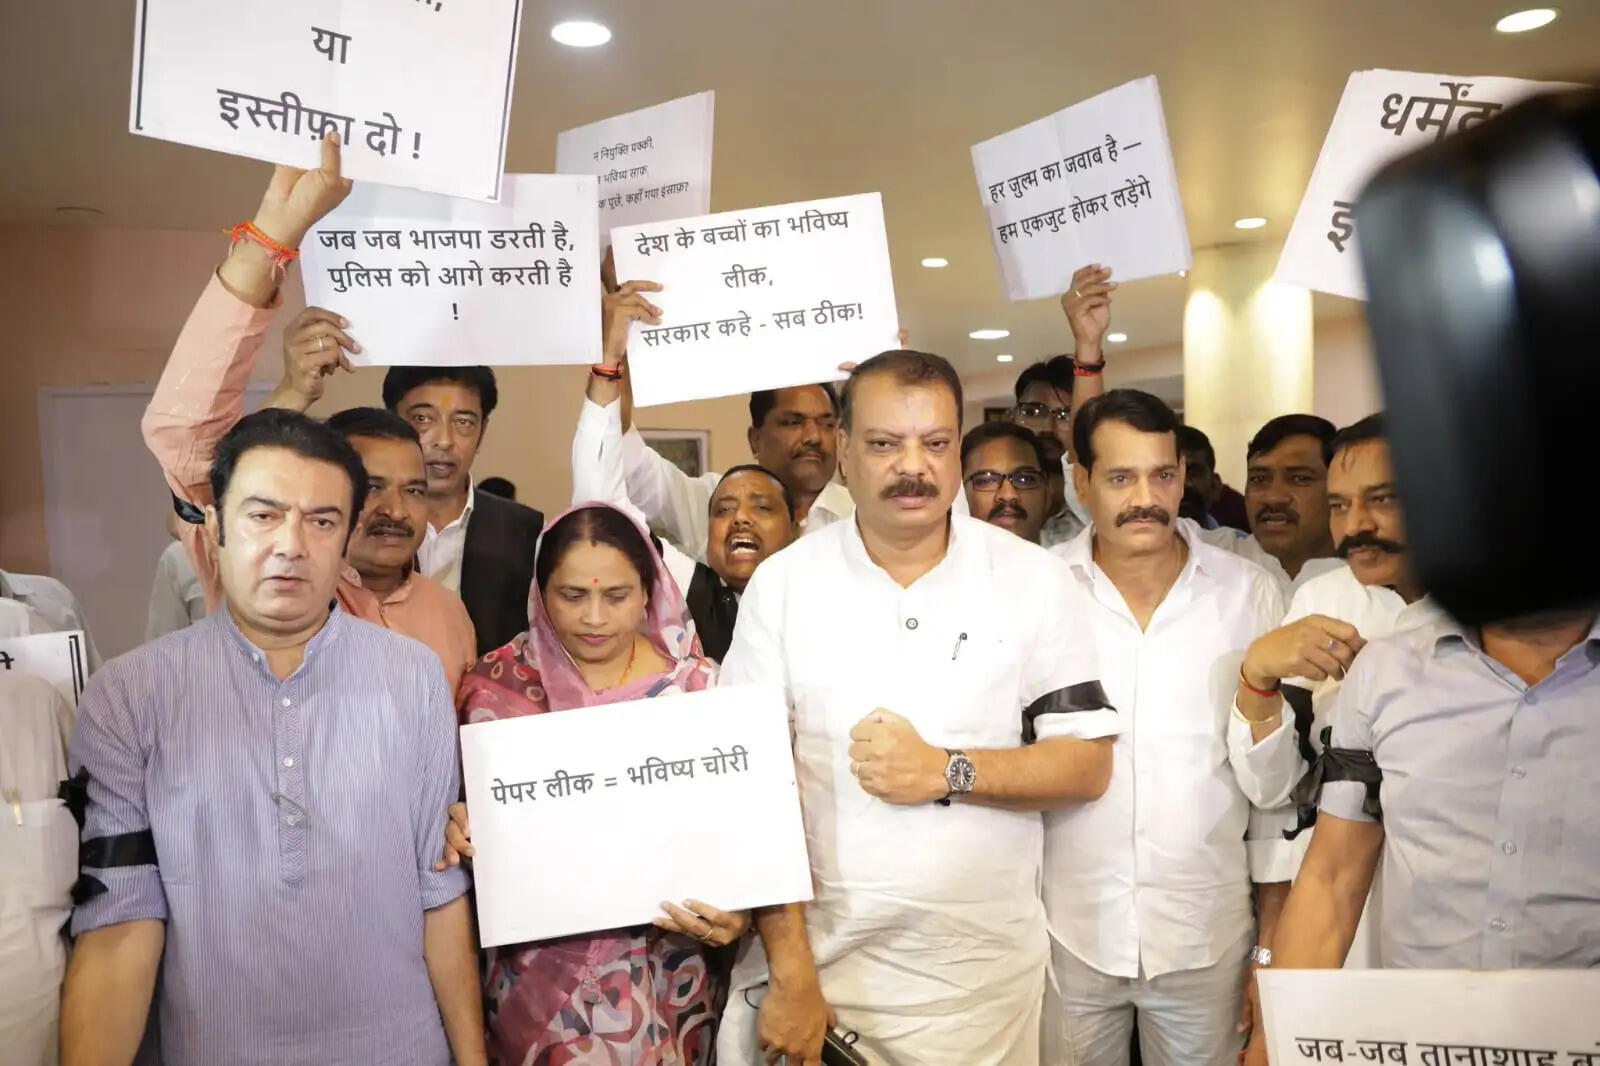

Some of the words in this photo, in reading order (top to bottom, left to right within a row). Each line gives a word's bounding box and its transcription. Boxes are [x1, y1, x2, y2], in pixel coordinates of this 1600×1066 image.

[310, 26, 353, 65] या
[364, 111, 403, 157] दो
[600, 143, 629, 161] नियुक्ति
[604, 169, 628, 183] भविष्य
[988, 181, 1006, 204] हर
[1007, 169, 1039, 199] जुल्म
[1039, 161, 1062, 182] का
[1063, 145, 1103, 173] जवाब
[1105, 133, 1118, 163] है
[625, 188, 643, 205] कहाँ
[645, 188, 660, 199] गया
[996, 222, 1019, 245] हम
[1019, 207, 1067, 238] एकजुट
[1068, 193, 1109, 224] होकर
[1110, 174, 1152, 208] लड़ेंगे
[316, 230, 357, 250] जब
[361, 230, 402, 250] जब
[409, 229, 482, 250] भाजपा
[487, 222, 546, 250] डरती
[551, 220, 574, 252] है,
[634, 232, 670, 257] देश
[673, 226, 696, 249] के
[702, 219, 747, 245] बच्चों
[751, 219, 781, 239] का
[787, 209, 849, 234] भविष्य
[326, 260, 393, 293] पुलिस
[397, 260, 431, 287] को
[438, 259, 484, 287] आगे
[488, 259, 551, 286] करती
[555, 257, 574, 288] है
[721, 263, 773, 289] लीक,
[452, 302, 459, 321] !
[641, 321, 711, 347] सरकार
[715, 310, 752, 337] कहे
[772, 309, 806, 330] सब
[811, 299, 864, 325] ठीक!
[490, 777, 538, 805] पेपर
[542, 769, 595, 798] लीक
[626, 756, 695, 786] भविष्य
[700, 744, 749, 775] चोरी
[1295, 1037, 1408, 1066] जब-जब
